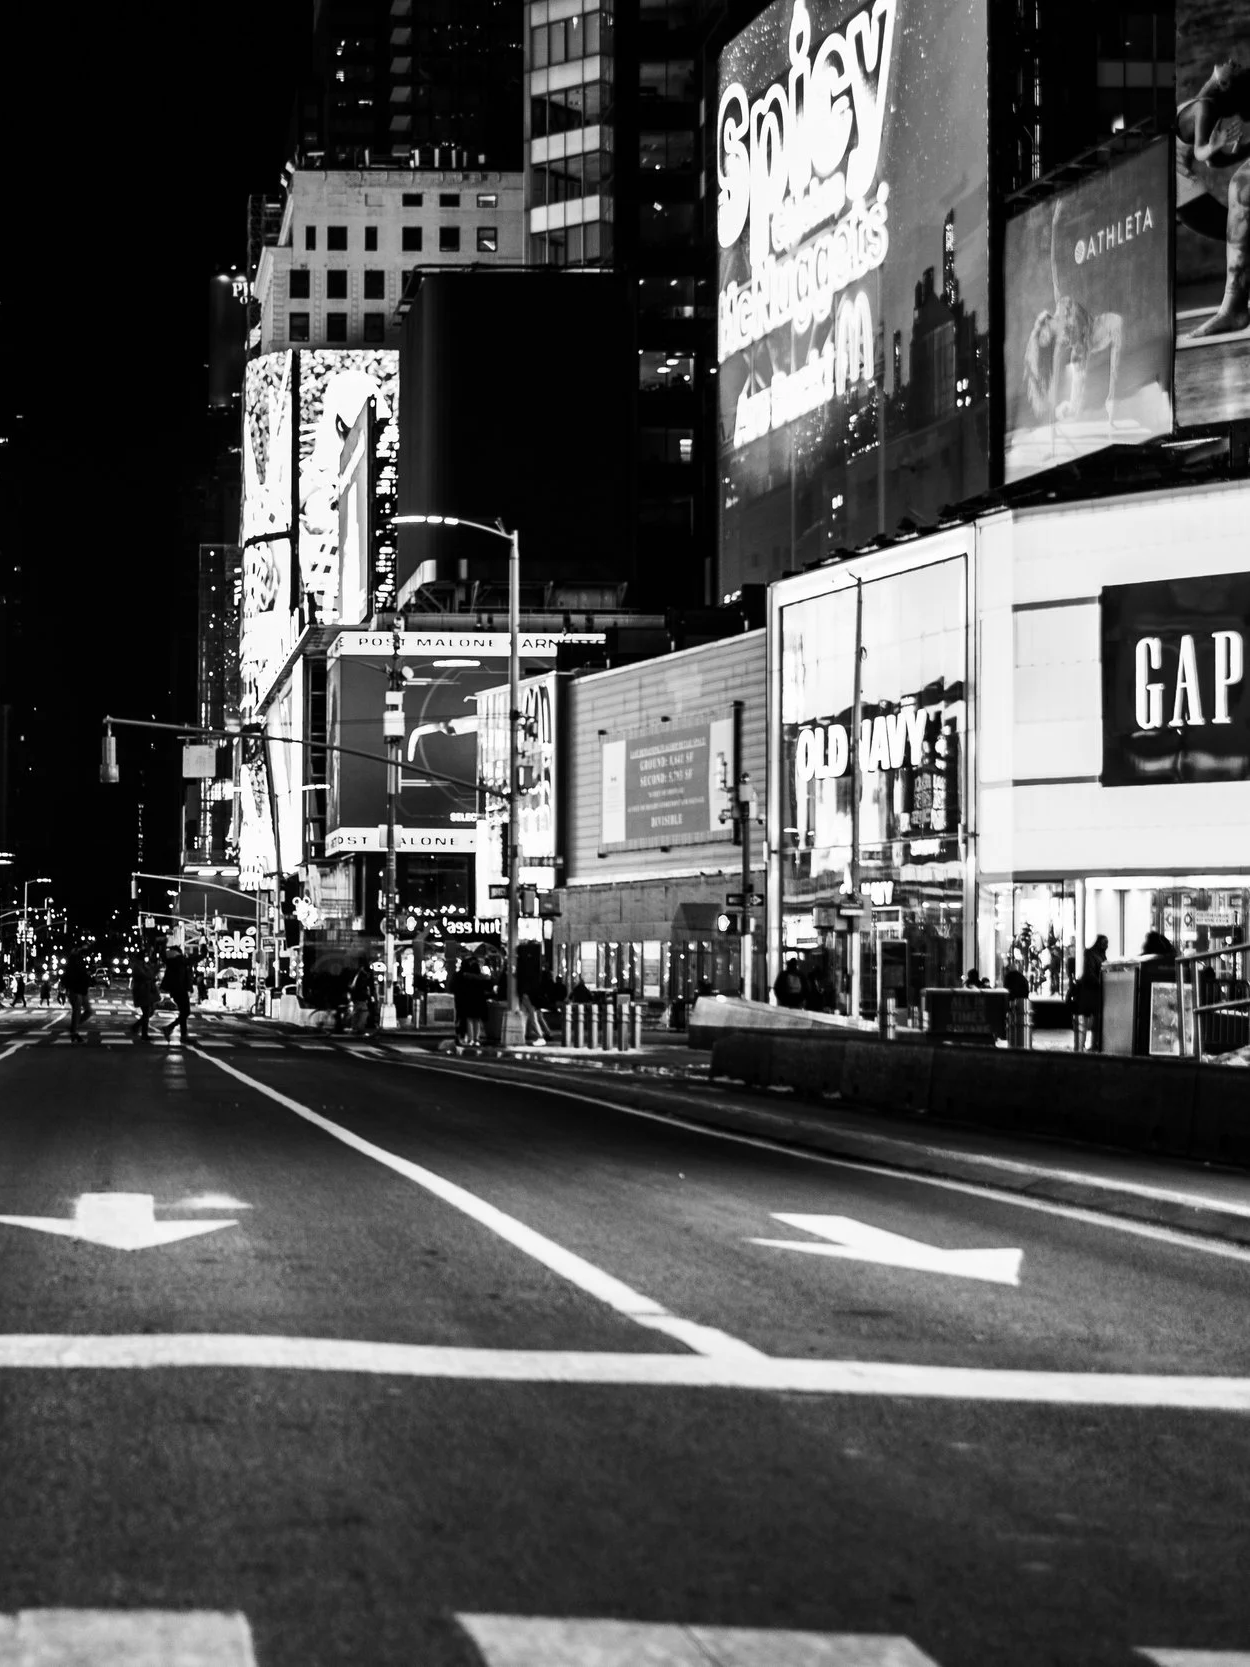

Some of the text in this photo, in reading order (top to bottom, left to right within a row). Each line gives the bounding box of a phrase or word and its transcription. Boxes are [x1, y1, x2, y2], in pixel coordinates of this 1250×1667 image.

[718, 0, 896, 264] Spicy
[1086, 206, 1154, 261] ATHLETA
[416, 638, 496, 648] MALONE
[1134, 629, 1243, 731] GAP
[796, 724, 849, 782] OLD
[400, 836, 460, 847] ALONE
[217, 926, 257, 954] elé
[474, 917, 502, 934] hut
